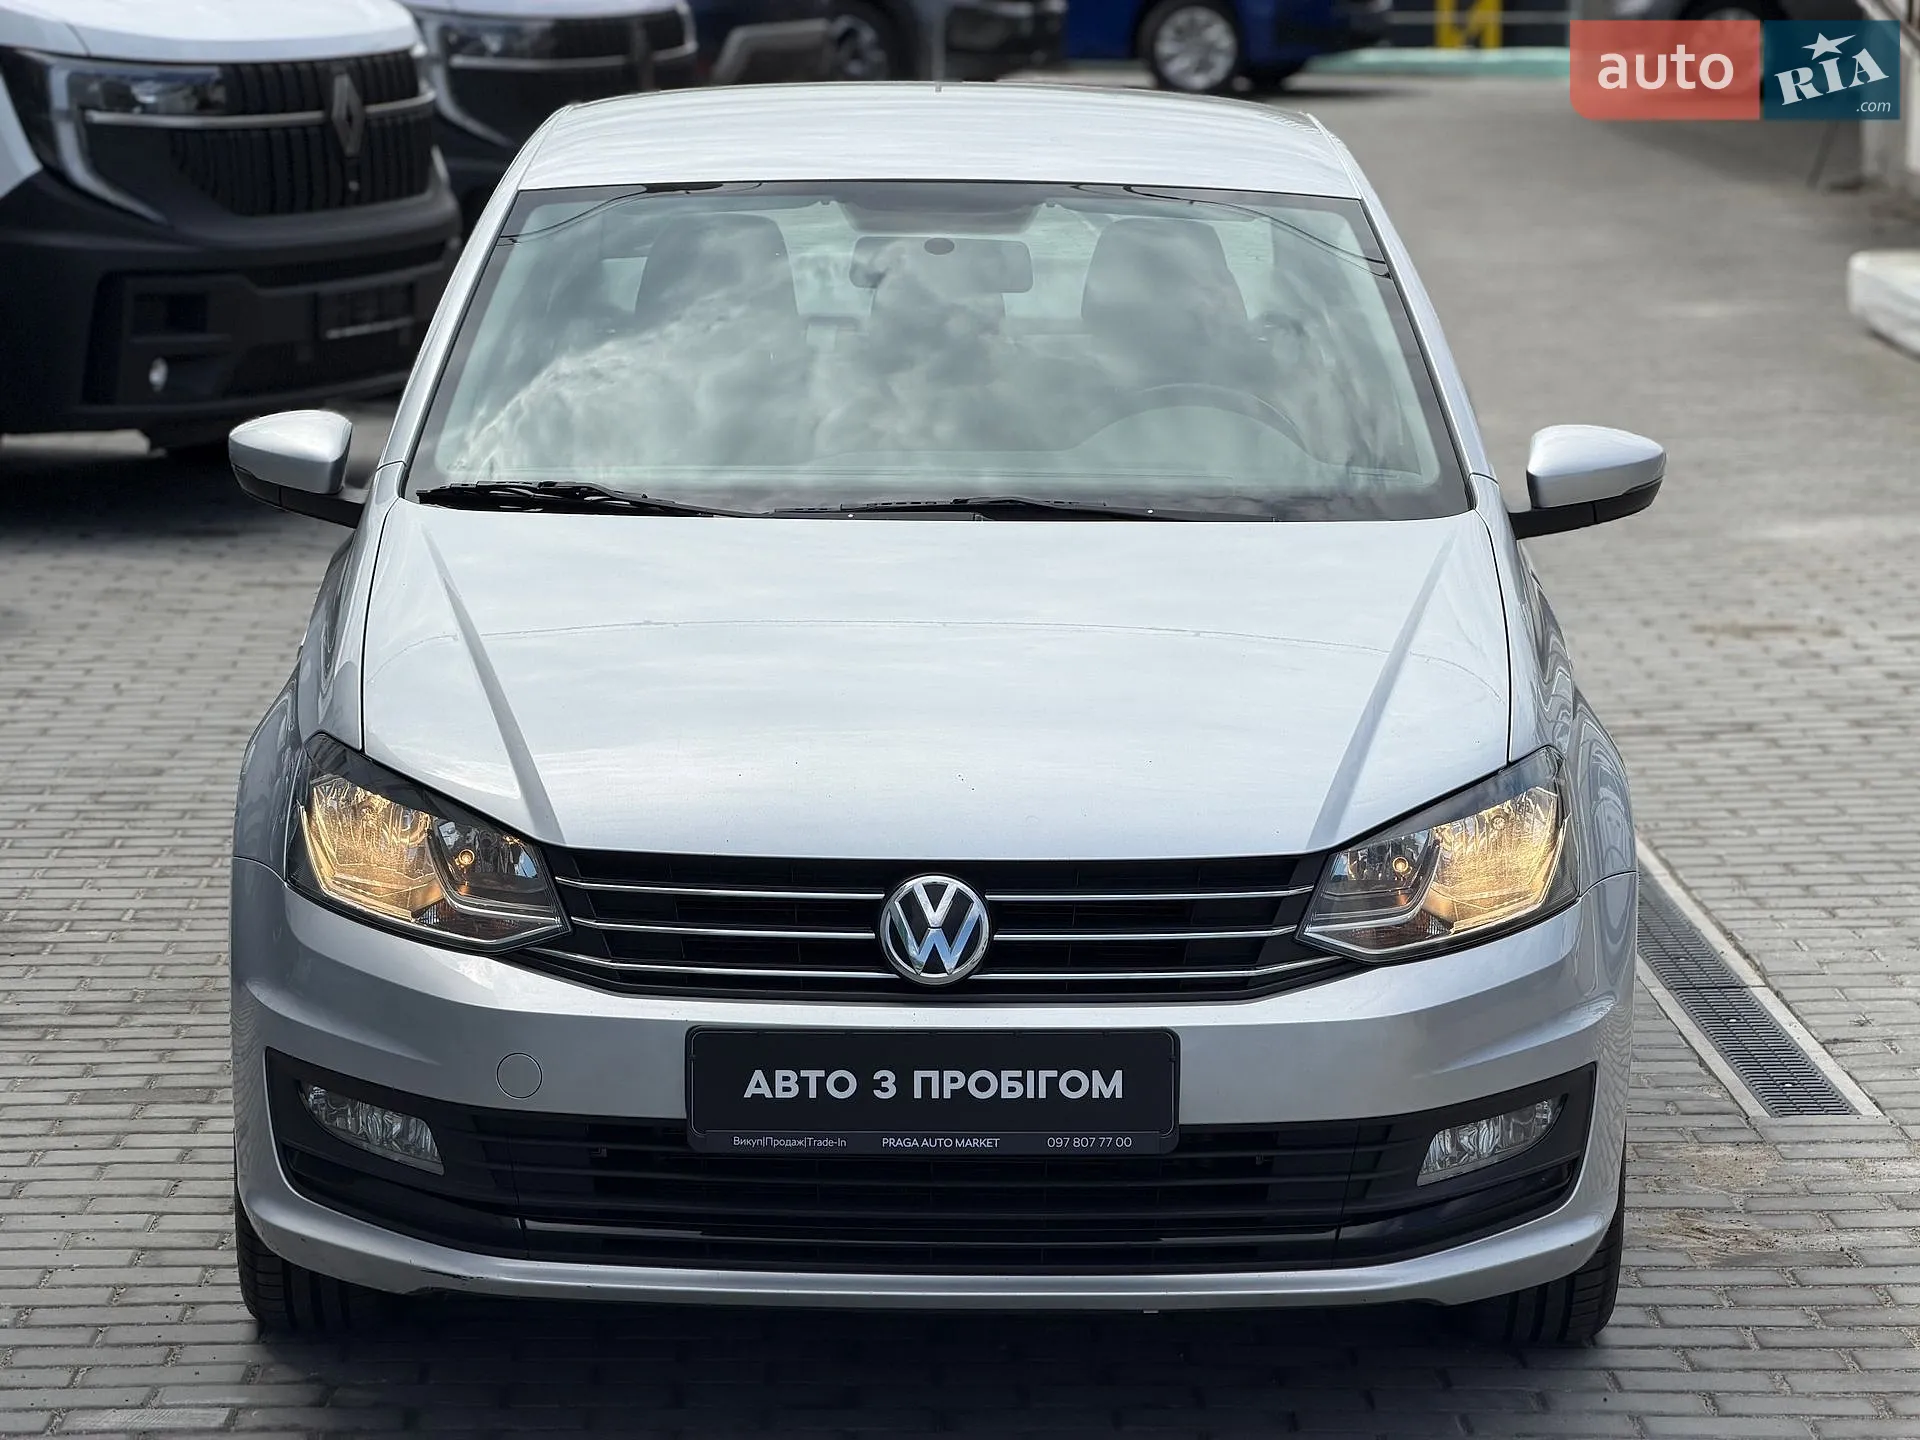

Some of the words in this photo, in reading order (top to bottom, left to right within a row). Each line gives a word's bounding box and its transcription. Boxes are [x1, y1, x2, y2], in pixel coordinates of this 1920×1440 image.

[743, 1069, 858, 1100] АВТО
[913, 1069, 1124, 1100] ПРОБІГОМ
[882, 1137, 919, 1149] PRAGA
[920, 1137, 953, 1149] AUTO
[954, 1137, 1001, 1149] MARKET
[1047, 1137, 1070, 1149] 097
[1072, 1137, 1096, 1149] 807
[1098, 1137, 1112, 1149] 77
[1115, 1137, 1134, 1149] 00
